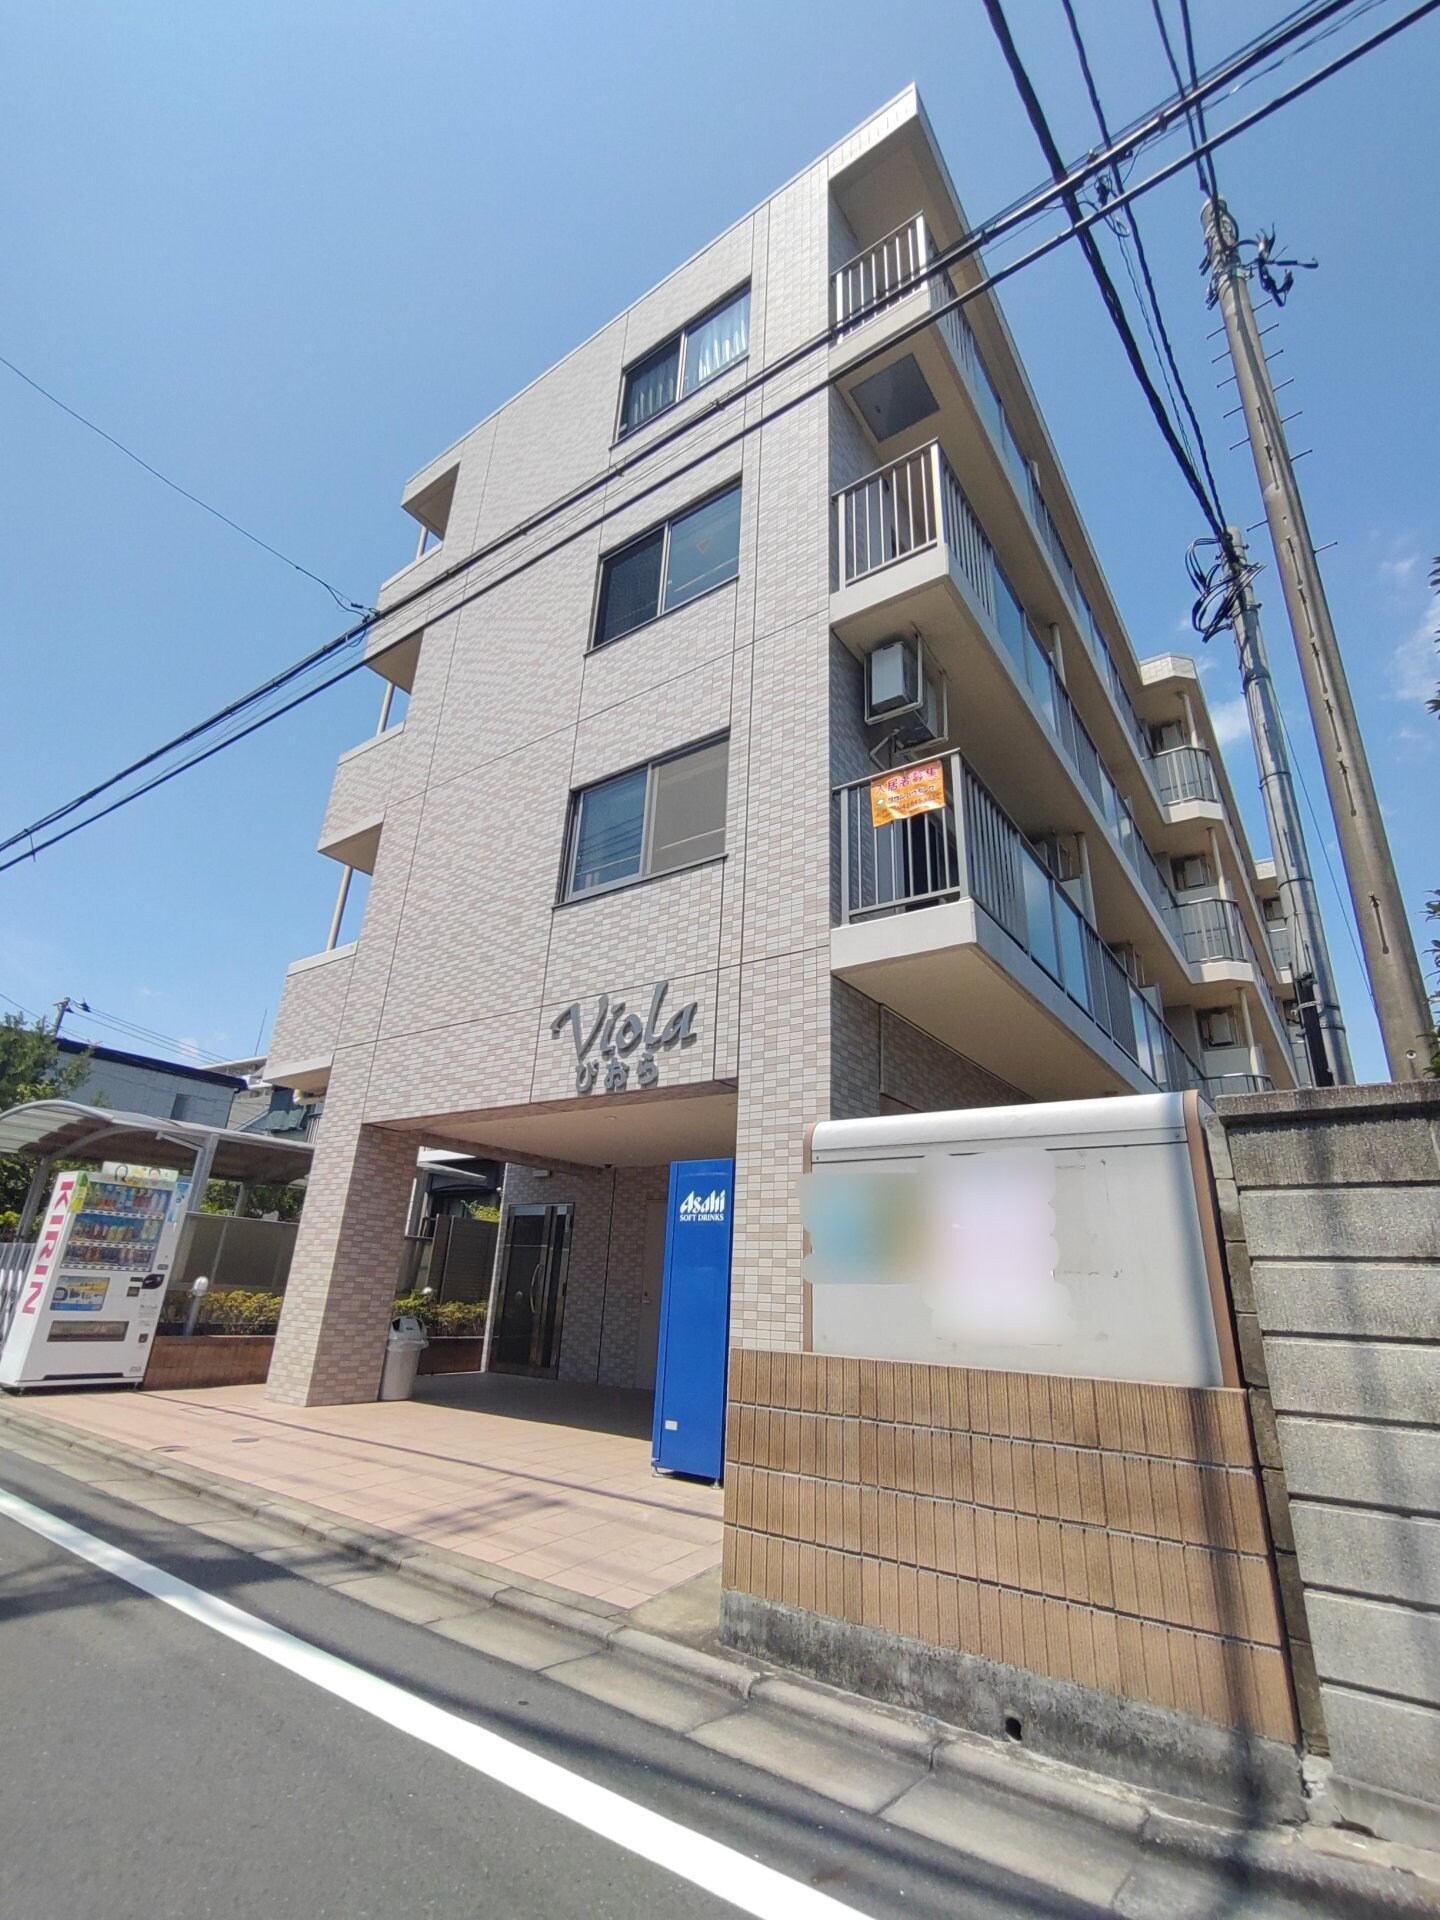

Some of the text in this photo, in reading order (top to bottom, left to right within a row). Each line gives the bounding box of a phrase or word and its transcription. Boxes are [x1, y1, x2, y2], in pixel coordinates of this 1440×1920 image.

[550, 981, 698, 1062] Viola
[575, 1052, 659, 1093] びおら
[680, 1190, 726, 1213] Asahi
[680, 1213, 724, 1222] SOFT DRINKS
[22, 1181, 74, 1314] KIRIN
